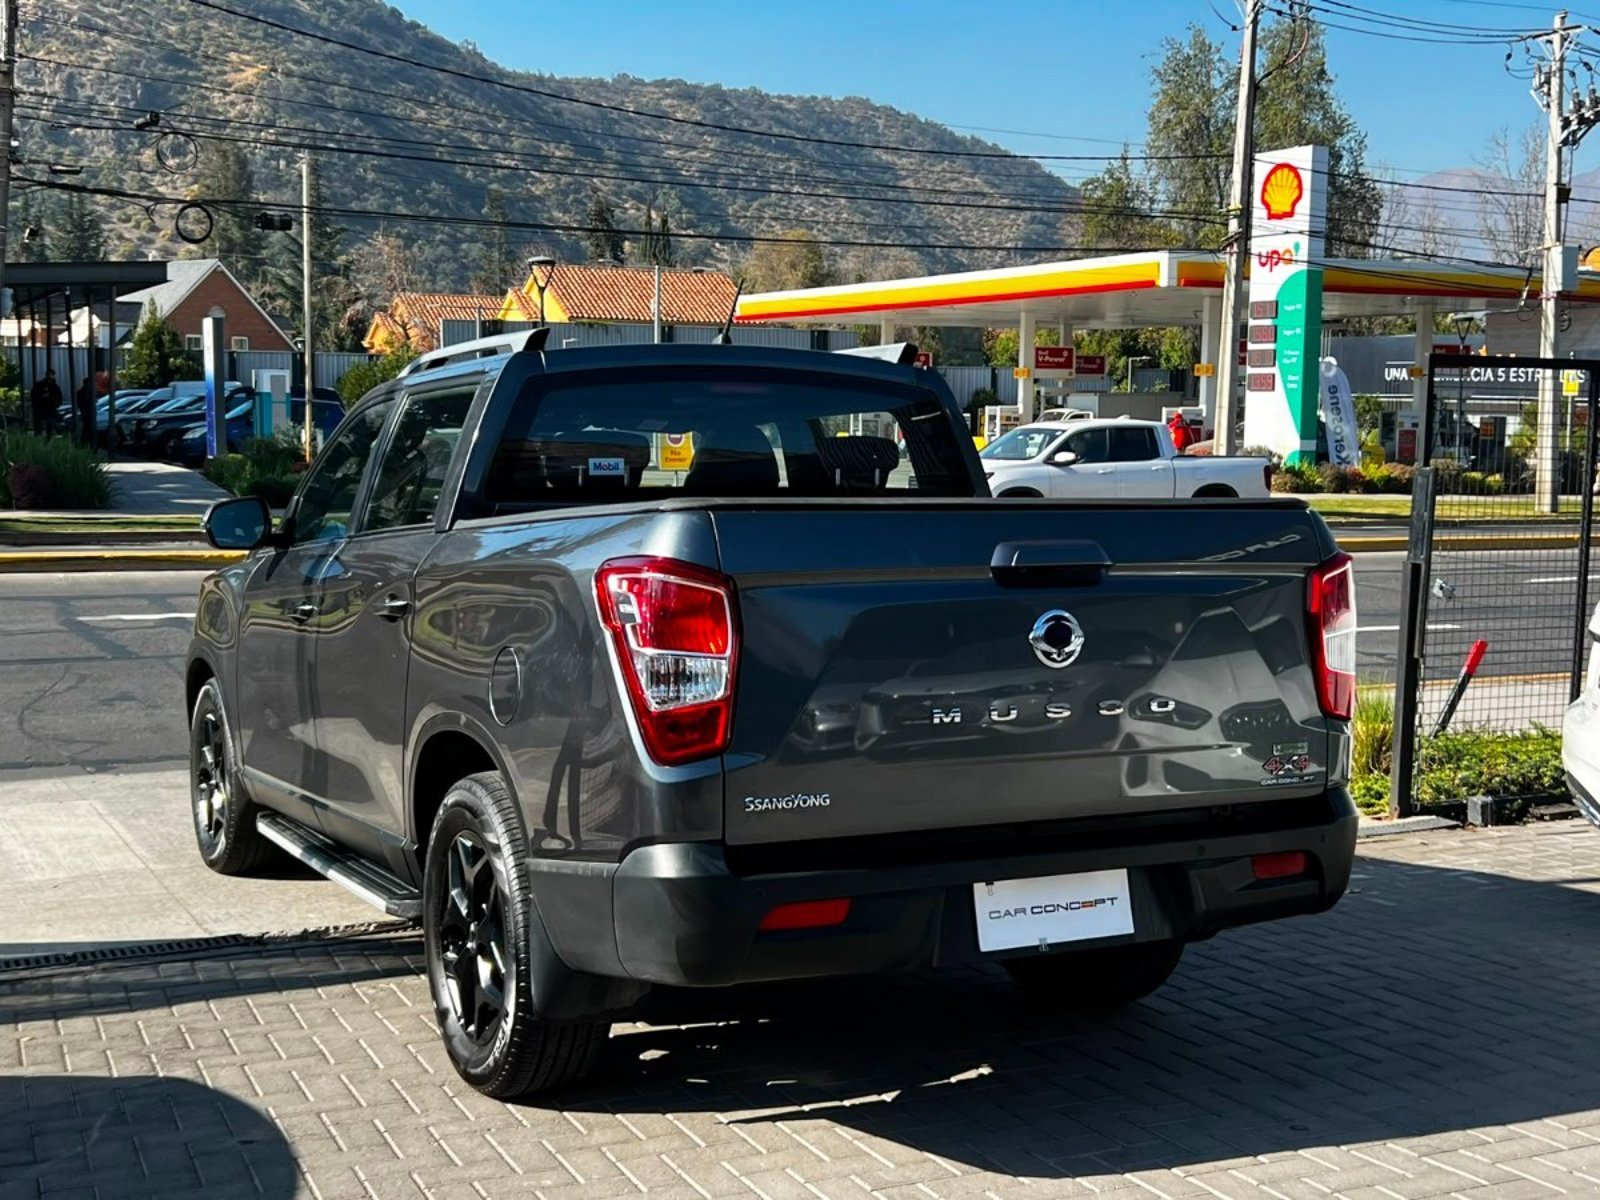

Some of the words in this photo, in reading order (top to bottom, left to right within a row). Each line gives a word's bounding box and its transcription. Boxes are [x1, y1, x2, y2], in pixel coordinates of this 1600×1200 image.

[1384, 367, 1409, 381] UNA
[1497, 367, 1506, 382] 5
[592, 461, 620, 472] Mobil
[931, 698, 1177, 725] MUSSO
[988, 906, 1027, 920] CAR
[1030, 896, 1119, 916] CONCEPT
